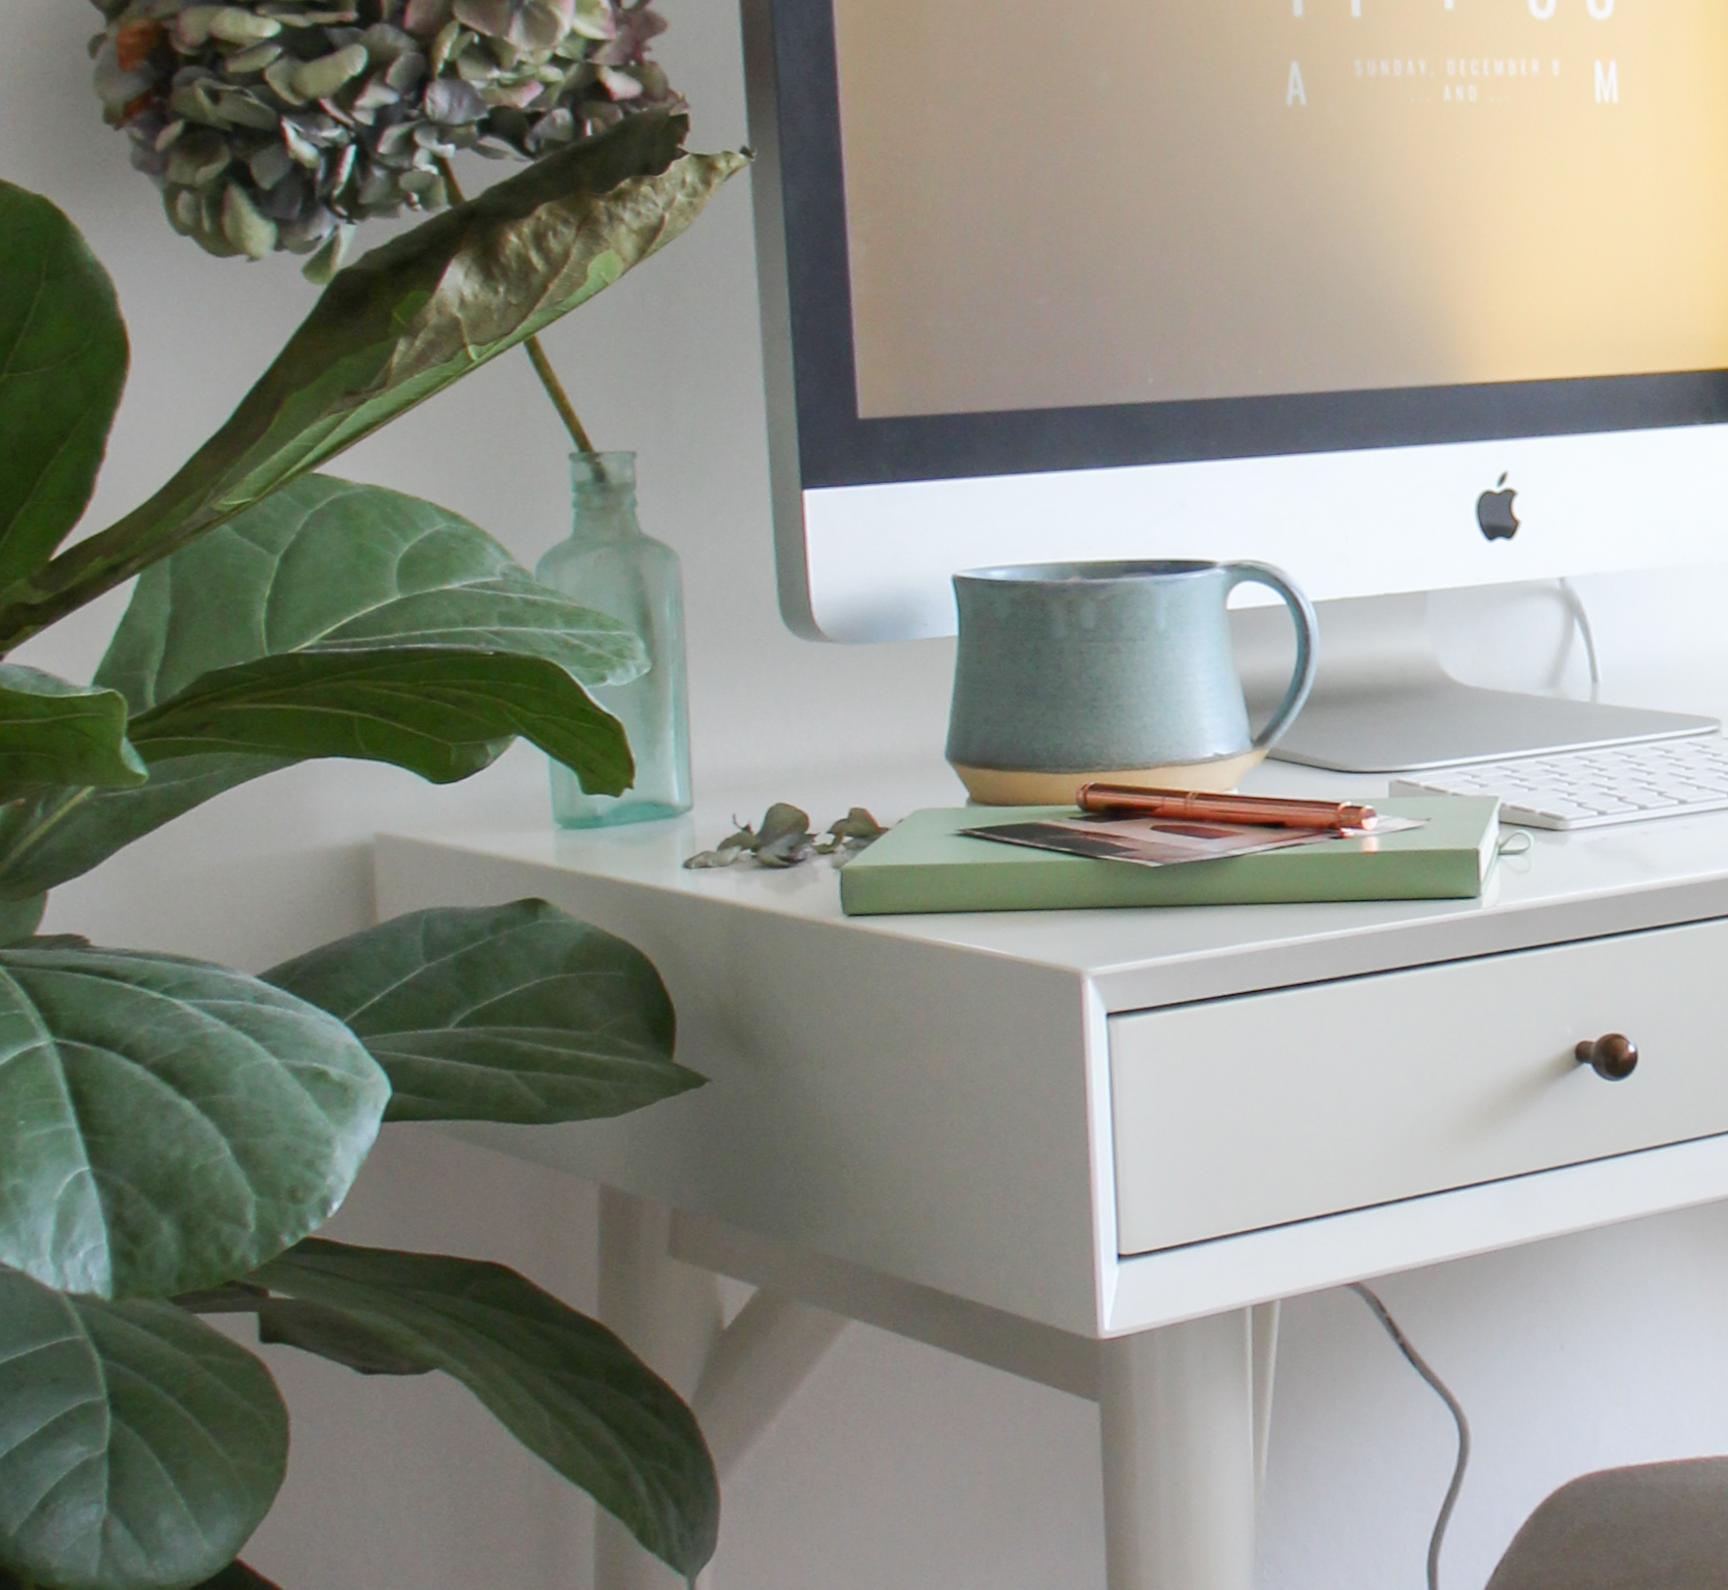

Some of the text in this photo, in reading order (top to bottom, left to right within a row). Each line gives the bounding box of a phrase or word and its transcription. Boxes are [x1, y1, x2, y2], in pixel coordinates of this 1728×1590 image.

[1446, 58, 1541, 77] DECEMBER
[1286, 59, 1620, 106] A M
[1442, 84, 1479, 102] AND
